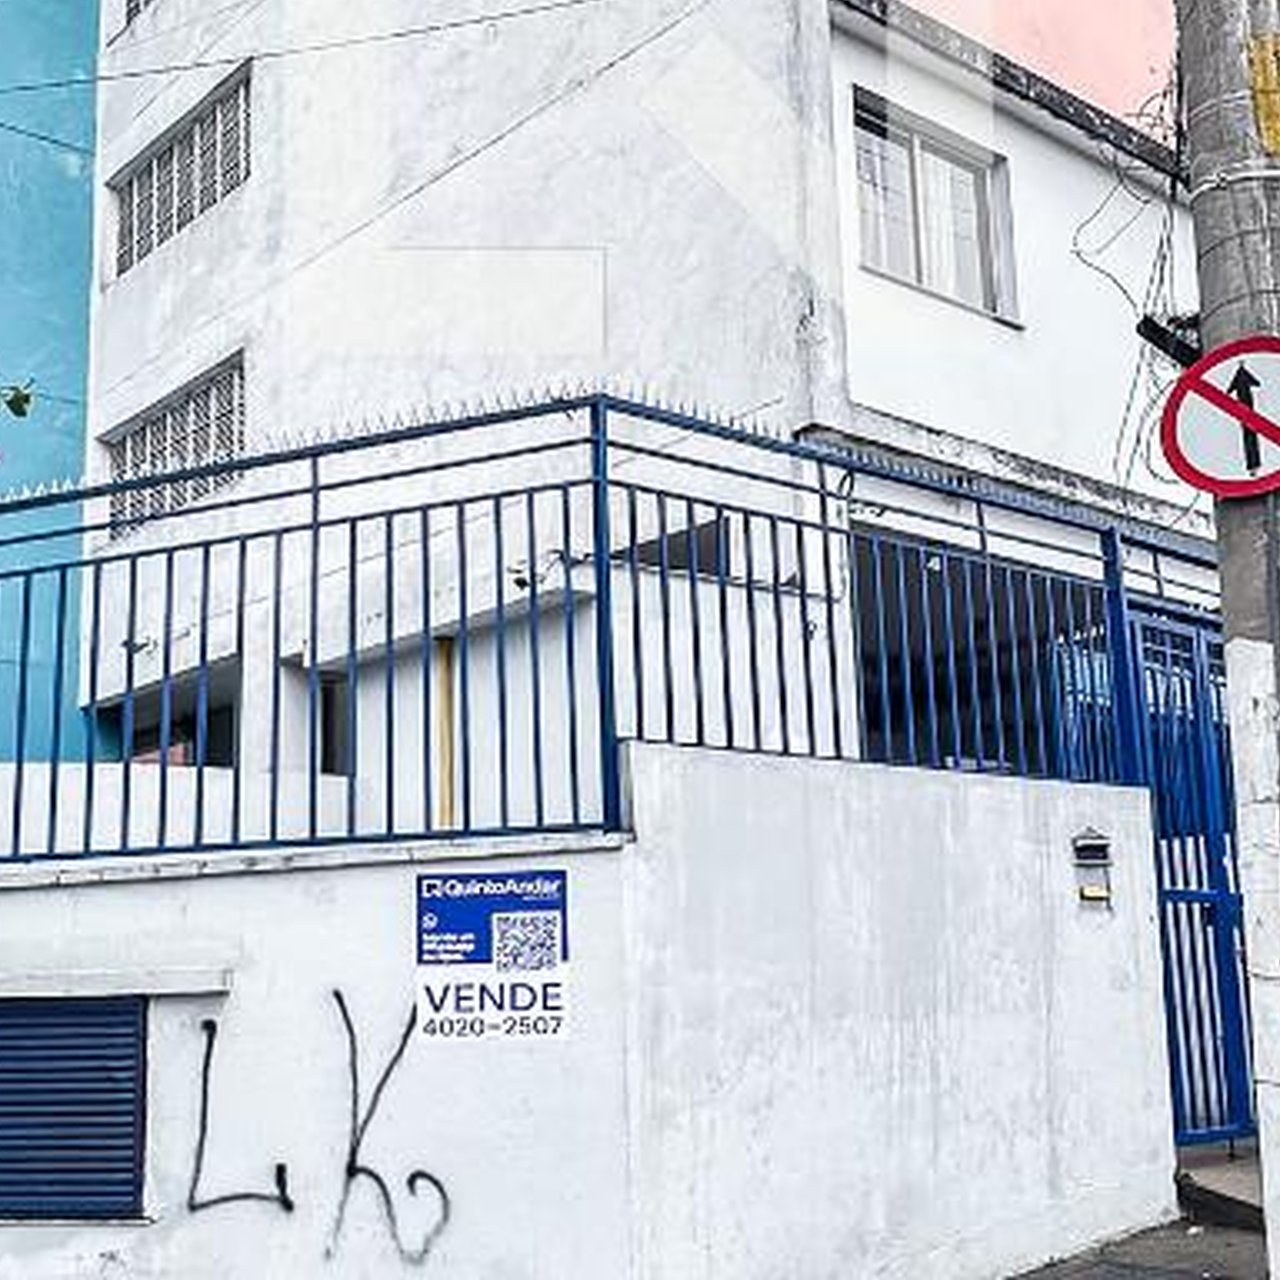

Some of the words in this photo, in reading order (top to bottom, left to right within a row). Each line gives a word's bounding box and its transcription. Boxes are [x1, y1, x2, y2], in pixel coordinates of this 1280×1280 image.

[445, 877, 561, 896] QuintoAndar
[424, 982, 563, 1013] VENDE
[423, 1015, 563, 1037] 4020-2507
